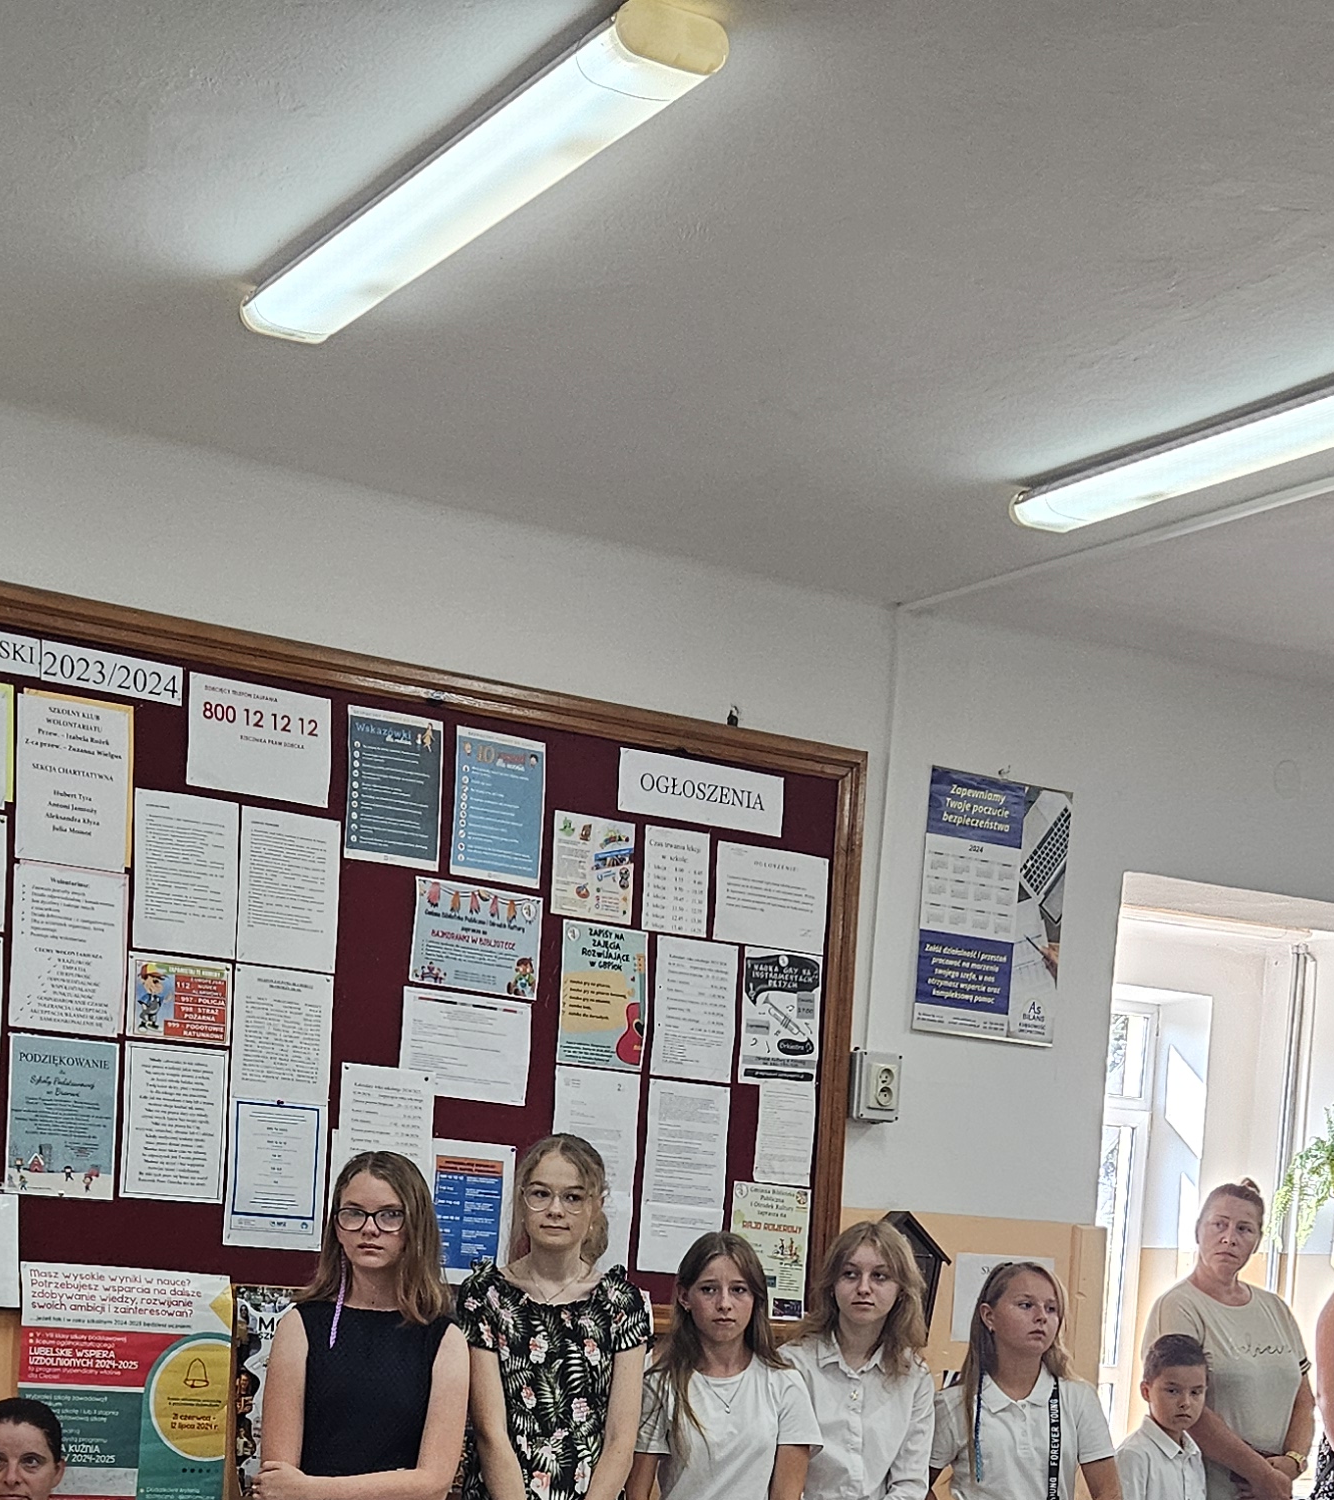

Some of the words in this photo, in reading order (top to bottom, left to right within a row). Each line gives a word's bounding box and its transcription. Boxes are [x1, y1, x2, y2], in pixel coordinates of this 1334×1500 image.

[43, 651, 178, 699] 2023/2024
[49, 706, 80, 718] SZKOLNY
[203, 702, 236, 723] 800
[244, 708, 264, 728] 12
[271, 713, 291, 733] 12
[298, 718, 318, 737] 12
[355, 722, 412, 740] Wskazówki
[640, 773, 765, 811] OGŁOSZENIA
[950, 784, 1006, 805] Zapewniamy
[946, 797, 971, 812] Twoje
[972, 804, 1009, 818] poczucie
[942, 811, 1010, 832] bezpieczeństwa
[589, 928, 612, 939] ZAPISY
[615, 933, 624, 941] NA
[592, 939, 620, 950] ZAJĘCIA
[582, 947, 630, 963] ROZWIJAJĄCE
[754, 964, 778, 972] NAUKA
[752, 971, 813, 982] INSTRUMENTACH
[198, 998, 225, 1006] POLICJA
[1029, 1001, 1041, 1014] As
[198, 1006, 218, 1015] STRAŻ
[1023, 1013, 1045, 1022] BILANS
[186, 1023, 224, 1032] POGOTOWIE
[183, 1031, 223, 1039] RATUNKOWE
[19, 1052, 109, 1070] PODZIĘKOWANIE
[30, 1269, 59, 1279] Masz
[62, 1271, 105, 1282] wysokie
[108, 1273, 142, 1284] wyniki
[156, 1276, 191, 1286] nauce?
[31, 1279, 99, 1291] Potrzebujesz
[102, 1283, 151, 1295] wsparcia
[154, 1287, 167, 1295] na
[169, 1287, 202, 1298] dalsze
[31, 1290, 96, 1302] zdobywanie
[99, 1293, 137, 1306] wiedzy,
[140, 1297, 193, 1308] rozwijanie
[31, 1300, 67, 1311] swoich
[69, 1302, 106, 1314] ambicji
[108, 1305, 111, 1313] i
[114, 1305, 193, 1319] zainteresowań?
[29, 1347, 73, 1356] LUBELSKIE
[76, 1349, 115, 1359] WSPIERA
[29, 1356, 93, 1367] UZDOLNIONYCH
[95, 1359, 138, 1369] 2024-2025
[178, 1422, 195, 1430] lipca
[69, 1443, 100, 1453] KUŹNIA
[71, 1454, 115, 1463] 2024-2025
